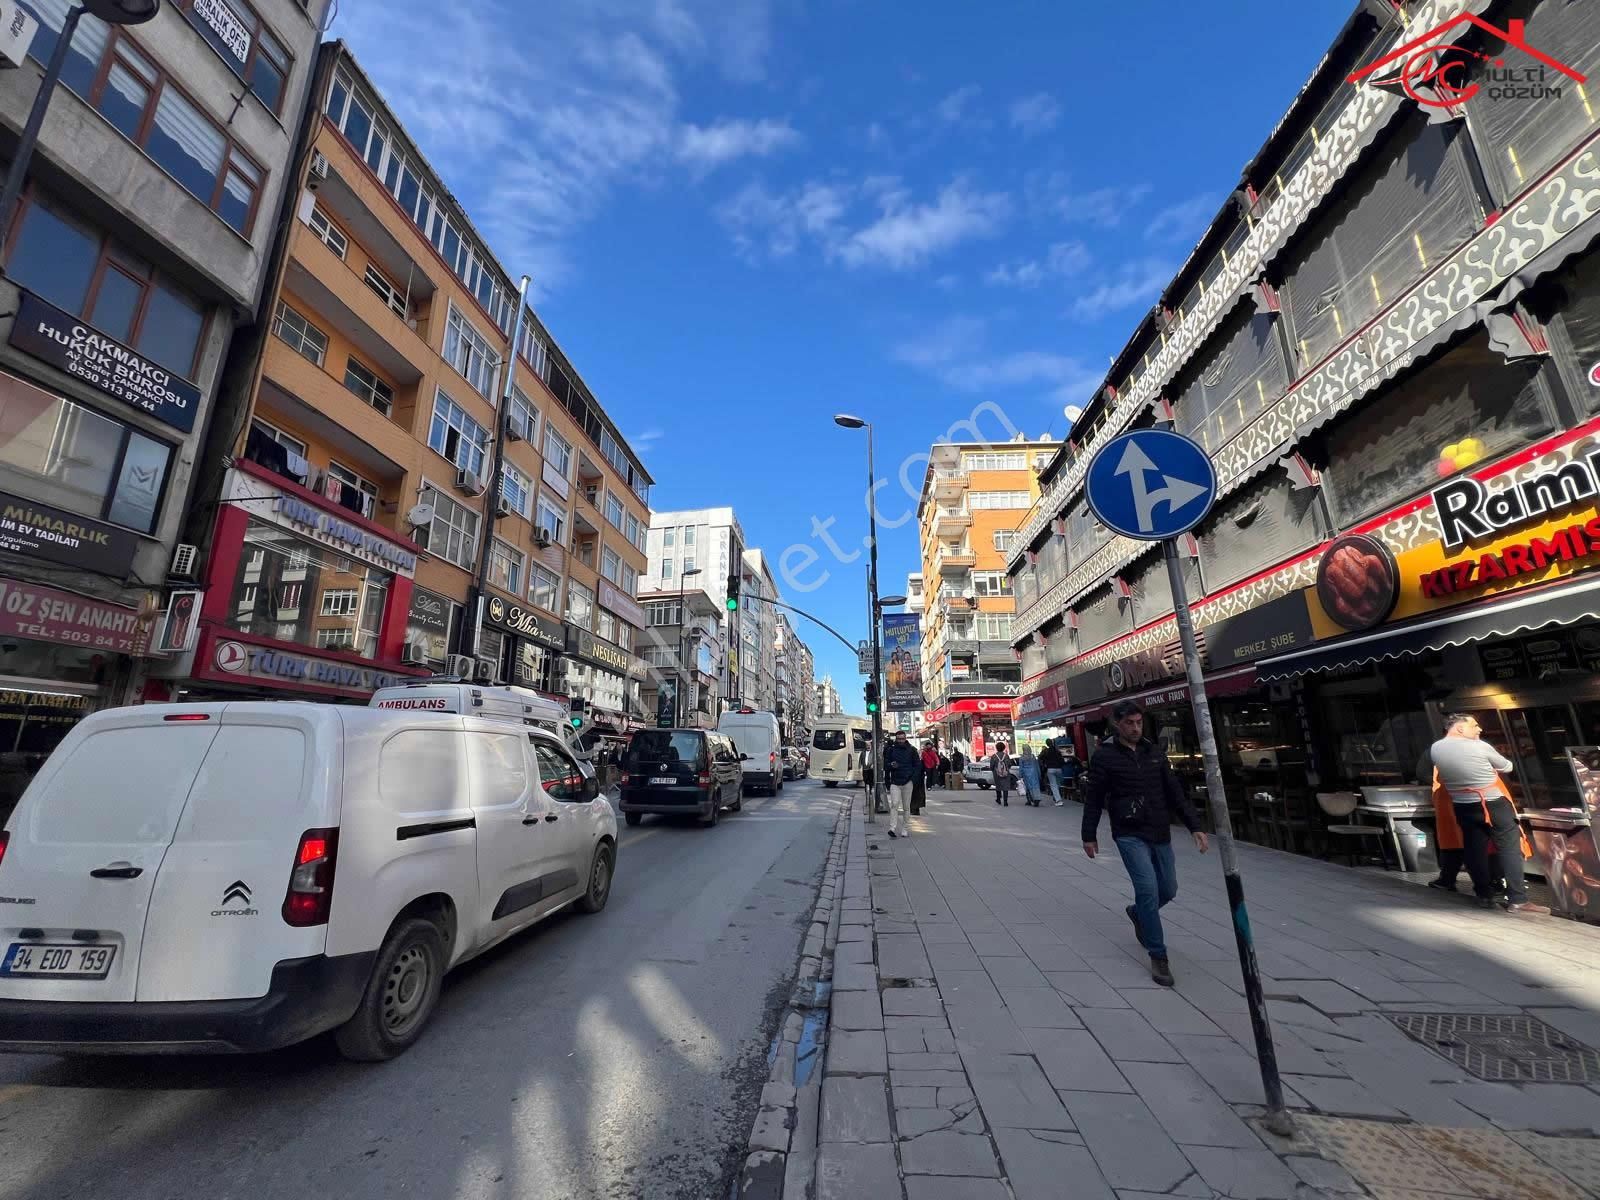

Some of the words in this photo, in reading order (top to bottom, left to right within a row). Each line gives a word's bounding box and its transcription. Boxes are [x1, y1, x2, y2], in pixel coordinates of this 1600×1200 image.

[229, 27, 248, 52] OFİS
[38, 322, 115, 369] HUKUK
[115, 364, 187, 408] BÜROSU
[72, 325, 169, 387] ÇAKMAKCI
[84, 359, 111, 377] Cafer
[68, 362, 100, 383] 0530
[100, 379, 123, 395] 313
[125, 390, 140, 402] 87
[140, 399, 156, 411] 44
[1358, 375, 1380, 395] Sultan
[1385, 352, 1413, 376] Lounge
[3, 505, 111, 546] MİMARLIK
[18, 522, 34, 535] EV
[35, 526, 80, 549] TADİLATI
[719, 530, 728, 582] GRAND
[6, 587, 33, 616] ÖZ
[37, 598, 76, 623] ŞEN
[16, 622, 56, 638] TEL:
[61, 629, 90, 643] 503
[95, 635, 114, 647] 84
[506, 606, 539, 636] Mia
[592, 642, 627, 669] NESLİŞAH
[1233, 640, 1267, 658] MERKEZ
[248, 649, 306, 678] TÜRK
[309, 661, 363, 688] HAVA
[377, 699, 447, 710] AMBULANS
[13, 948, 33, 970] 34
[39, 949, 73, 970] EDD
[79, 949, 108, 971] 159
